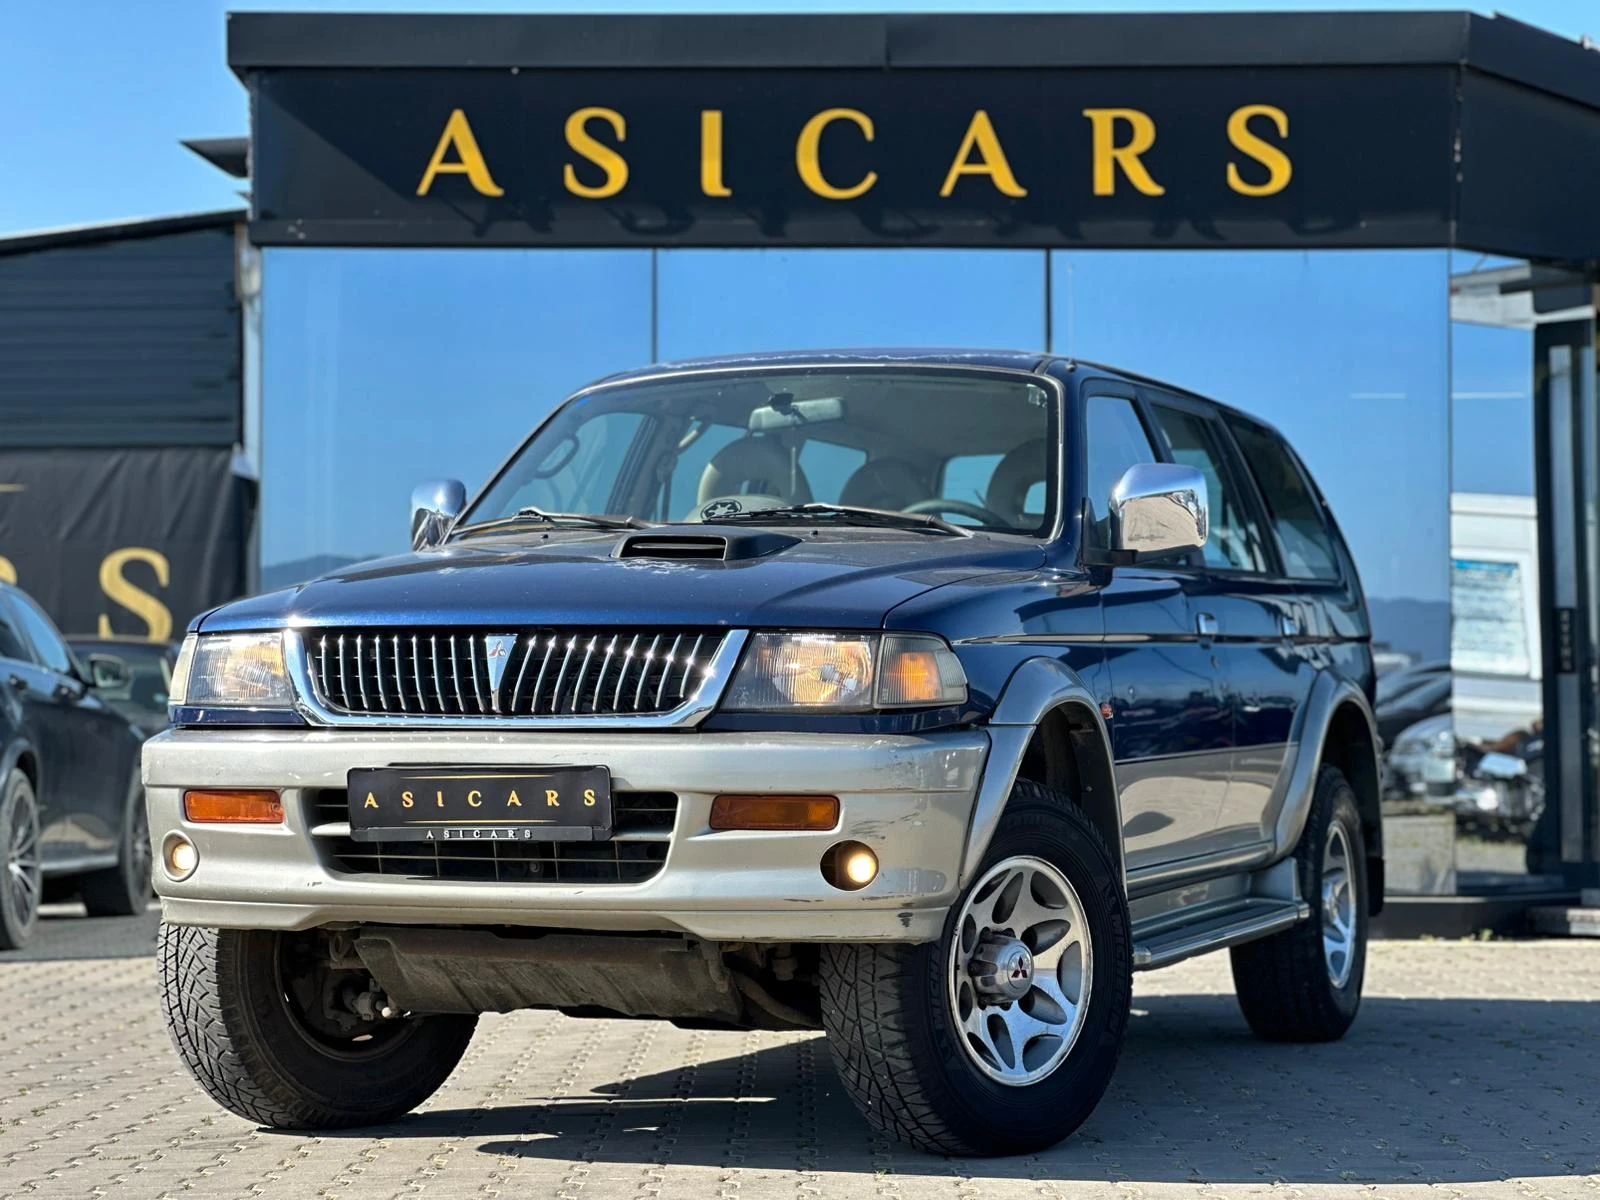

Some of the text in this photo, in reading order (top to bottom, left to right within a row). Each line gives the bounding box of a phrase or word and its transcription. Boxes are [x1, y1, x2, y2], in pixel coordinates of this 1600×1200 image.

[417, 104, 1293, 199] ASICARS
[363, 788, 597, 808] ASICARS
[426, 829, 532, 839] ASICARS
